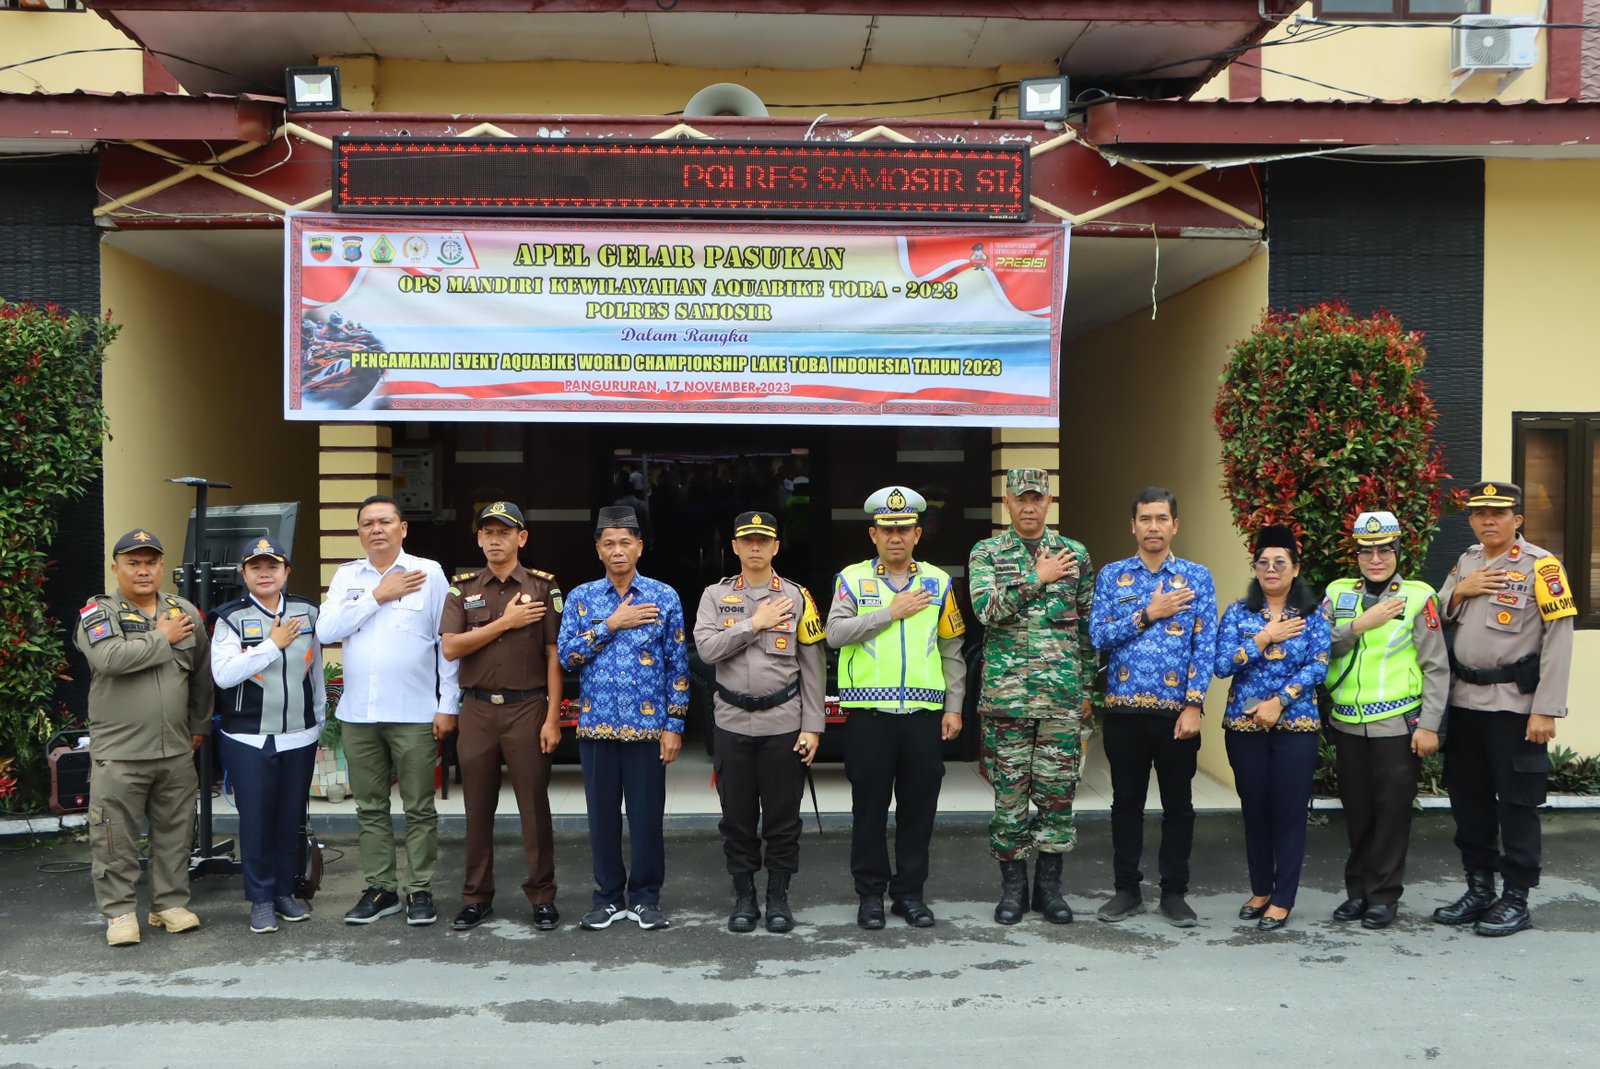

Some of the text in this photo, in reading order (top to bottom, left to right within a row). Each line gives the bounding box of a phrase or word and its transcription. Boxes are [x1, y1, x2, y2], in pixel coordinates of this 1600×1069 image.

[818, 166, 964, 192] SAMOSIR
[514, 243, 846, 270] APEL GELAR PASUKAN
[995, 256, 1048, 269] PRESISI
[398, 275, 441, 293] OPS
[447, 276, 543, 295] MANDIRI
[549, 277, 706, 297] KEWILAYAHAN
[712, 279, 824, 298] AQUABIKE
[830, 280, 888, 298] TOBA
[906, 281, 959, 299] 2023
[586, 301, 773, 321] POLRES SAMOSIR
[621, 327, 750, 347] Dalam Rangka
[351, 352, 1003, 376] PENGAMANAN EVENT AQUABIKE WORLD CHAMPIONSHIP LAKE TOBA INDONESIA TAHUN 2023
[564, 380, 791, 395] PANGURURAN, 17 NOVEMBER 2023
